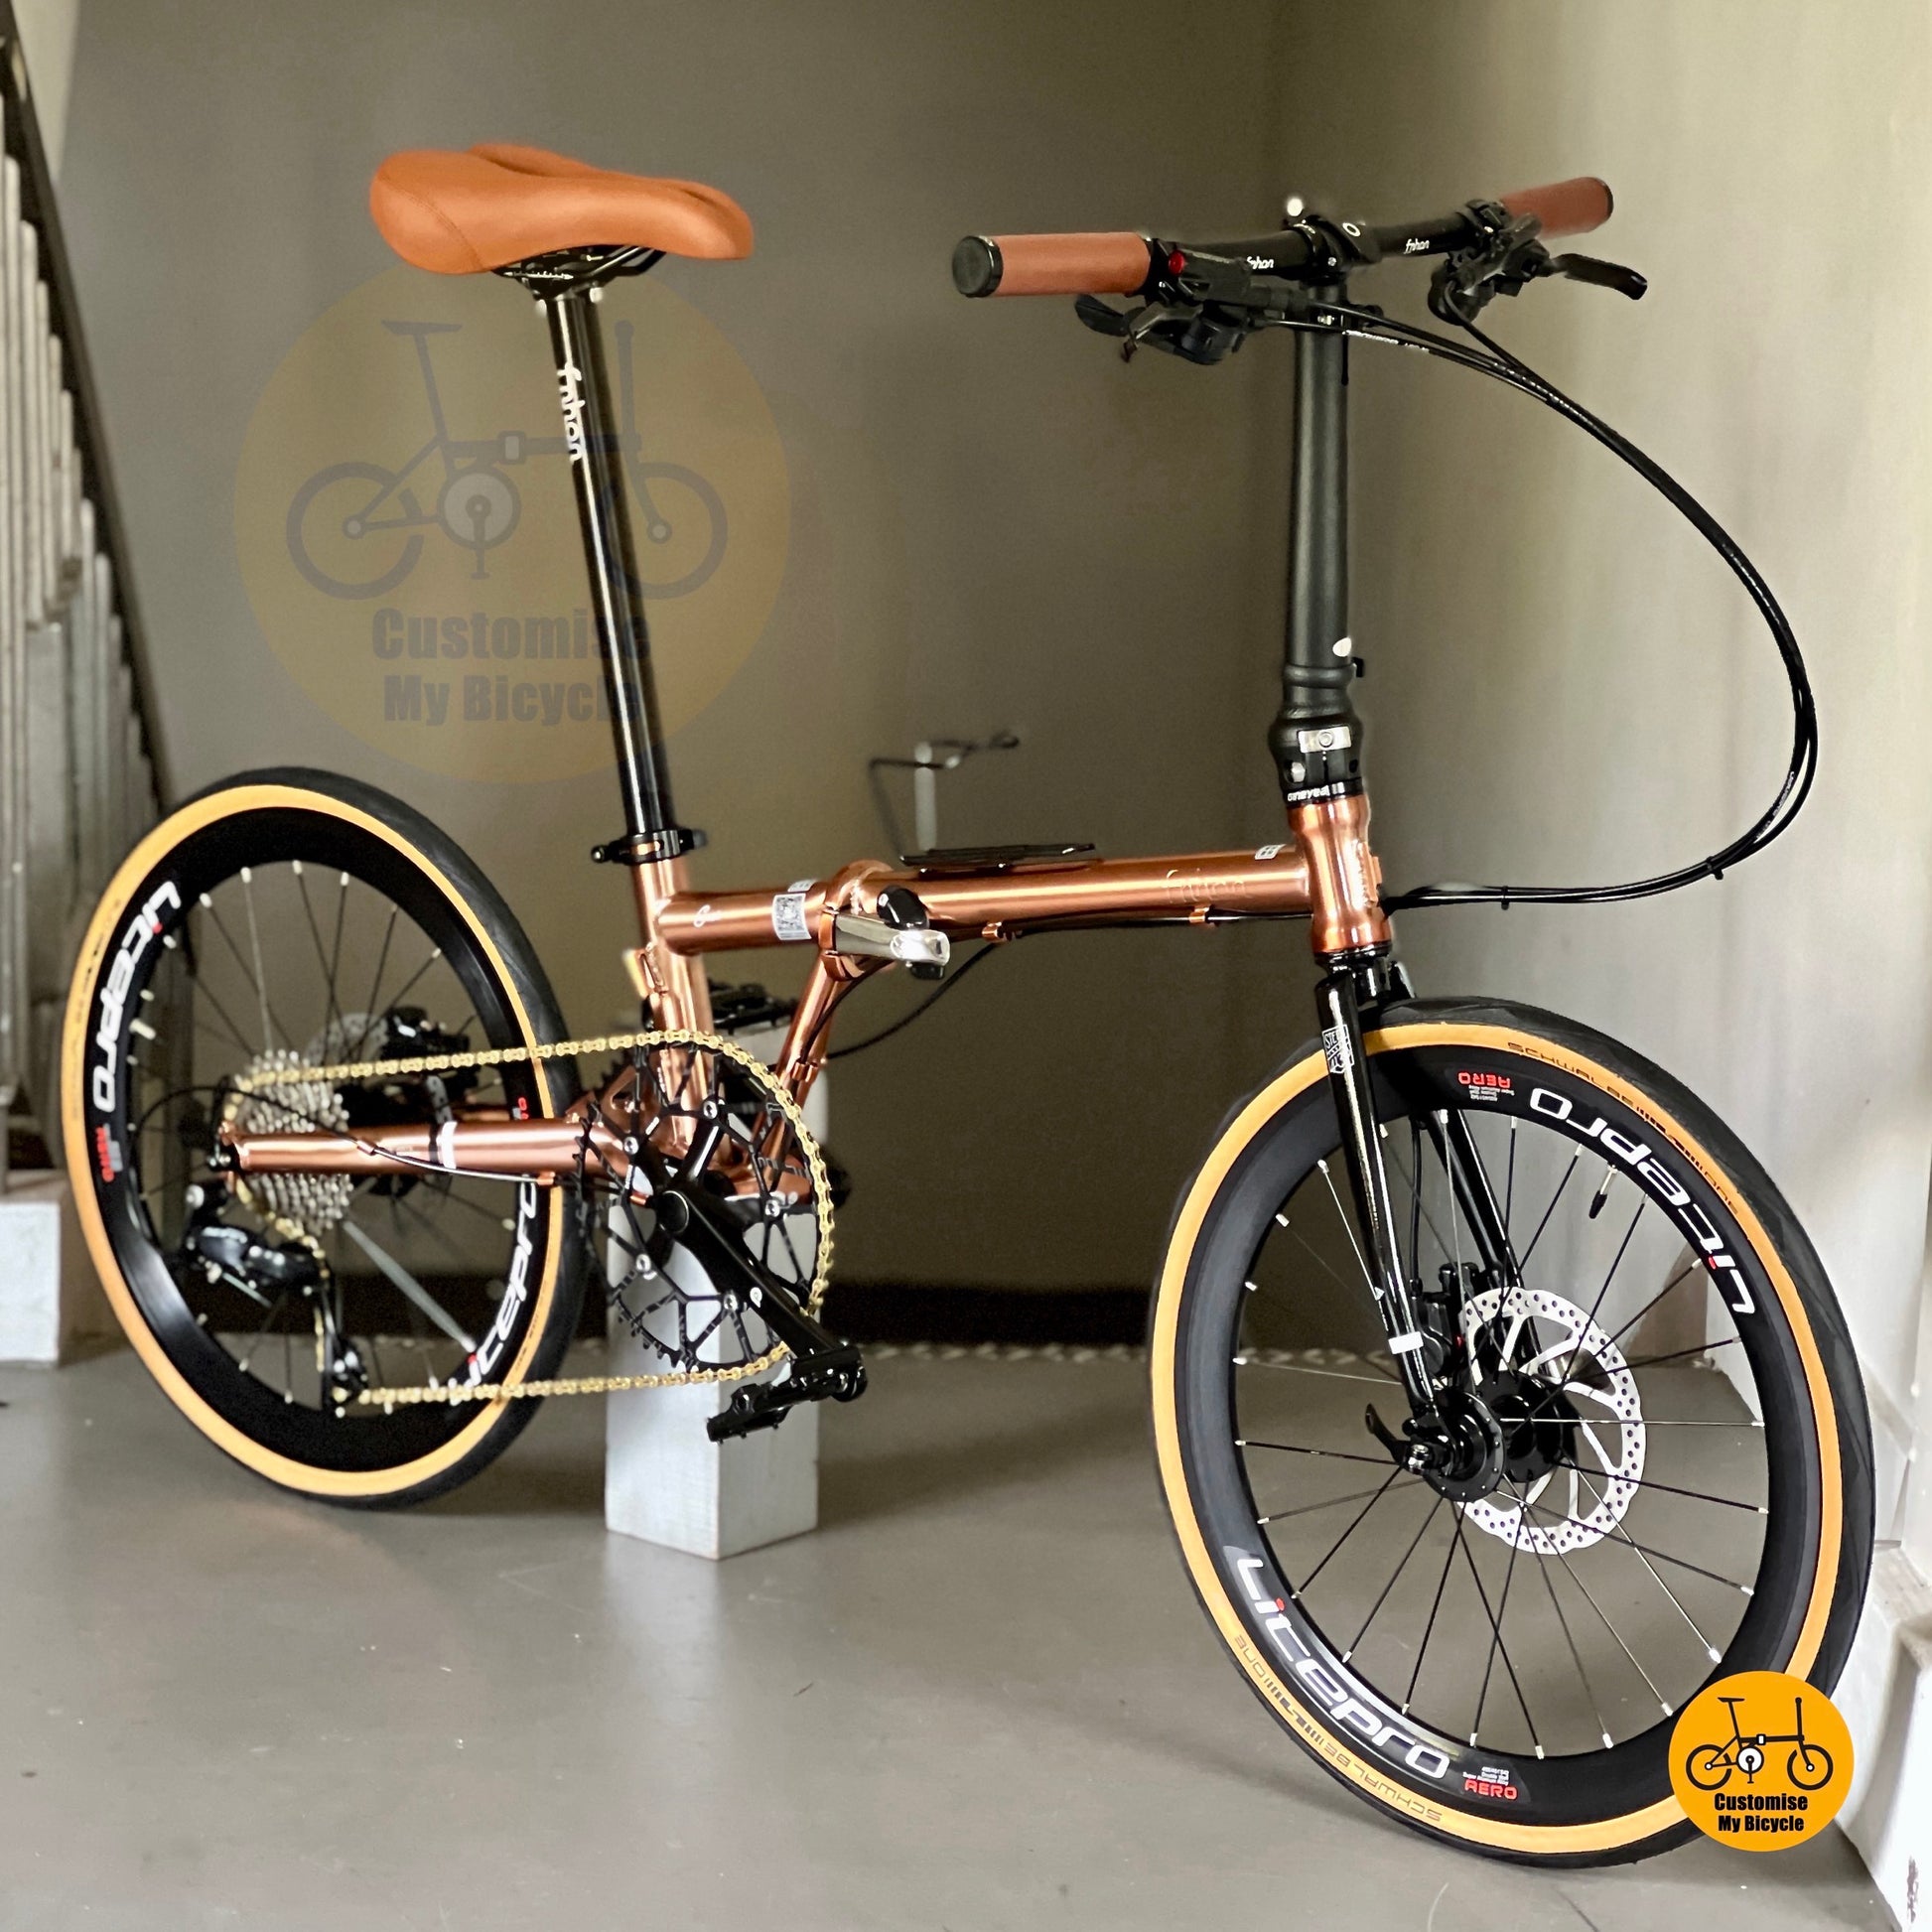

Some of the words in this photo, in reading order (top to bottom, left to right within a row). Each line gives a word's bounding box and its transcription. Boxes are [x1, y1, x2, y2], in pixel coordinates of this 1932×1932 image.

[1457, 1072, 1511, 1089] AERO
[1507, 1042, 1634, 1108] SCHWALBE
[1324, 1743, 1444, 1823] SCHWALBE
[1464, 1779, 1518, 1800] AERO
